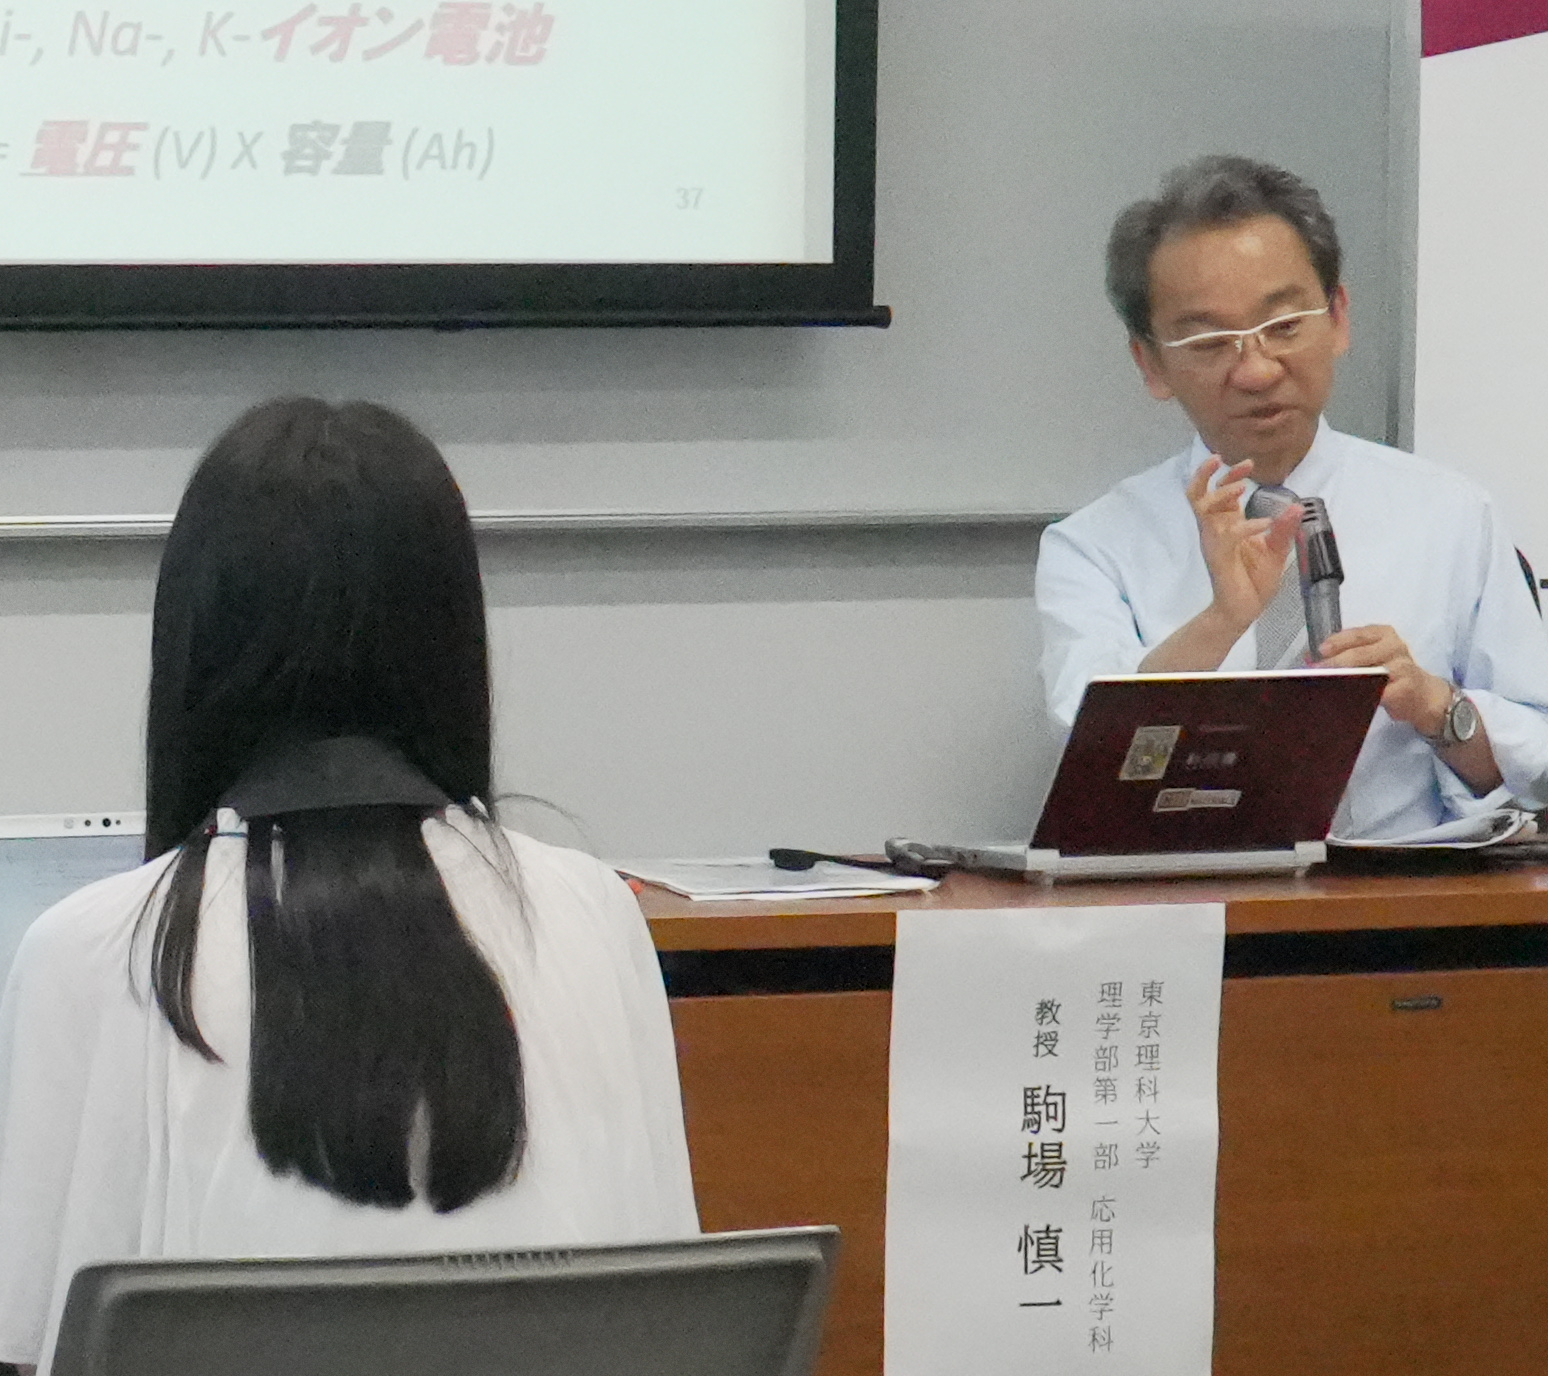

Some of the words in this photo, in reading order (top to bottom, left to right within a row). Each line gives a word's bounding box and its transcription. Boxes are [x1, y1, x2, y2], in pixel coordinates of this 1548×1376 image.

[1033, 997, 1062, 1058] 教授
[1093, 981, 1123, 1171] 理学部第一部
[1135, 980, 1164, 1169] 東京理科大学
[1020, 1084, 1067, 1190] 駒場
[1017, 1224, 1064, 1310] 慎一
[1088, 1195, 1116, 1354] 応用化学科
